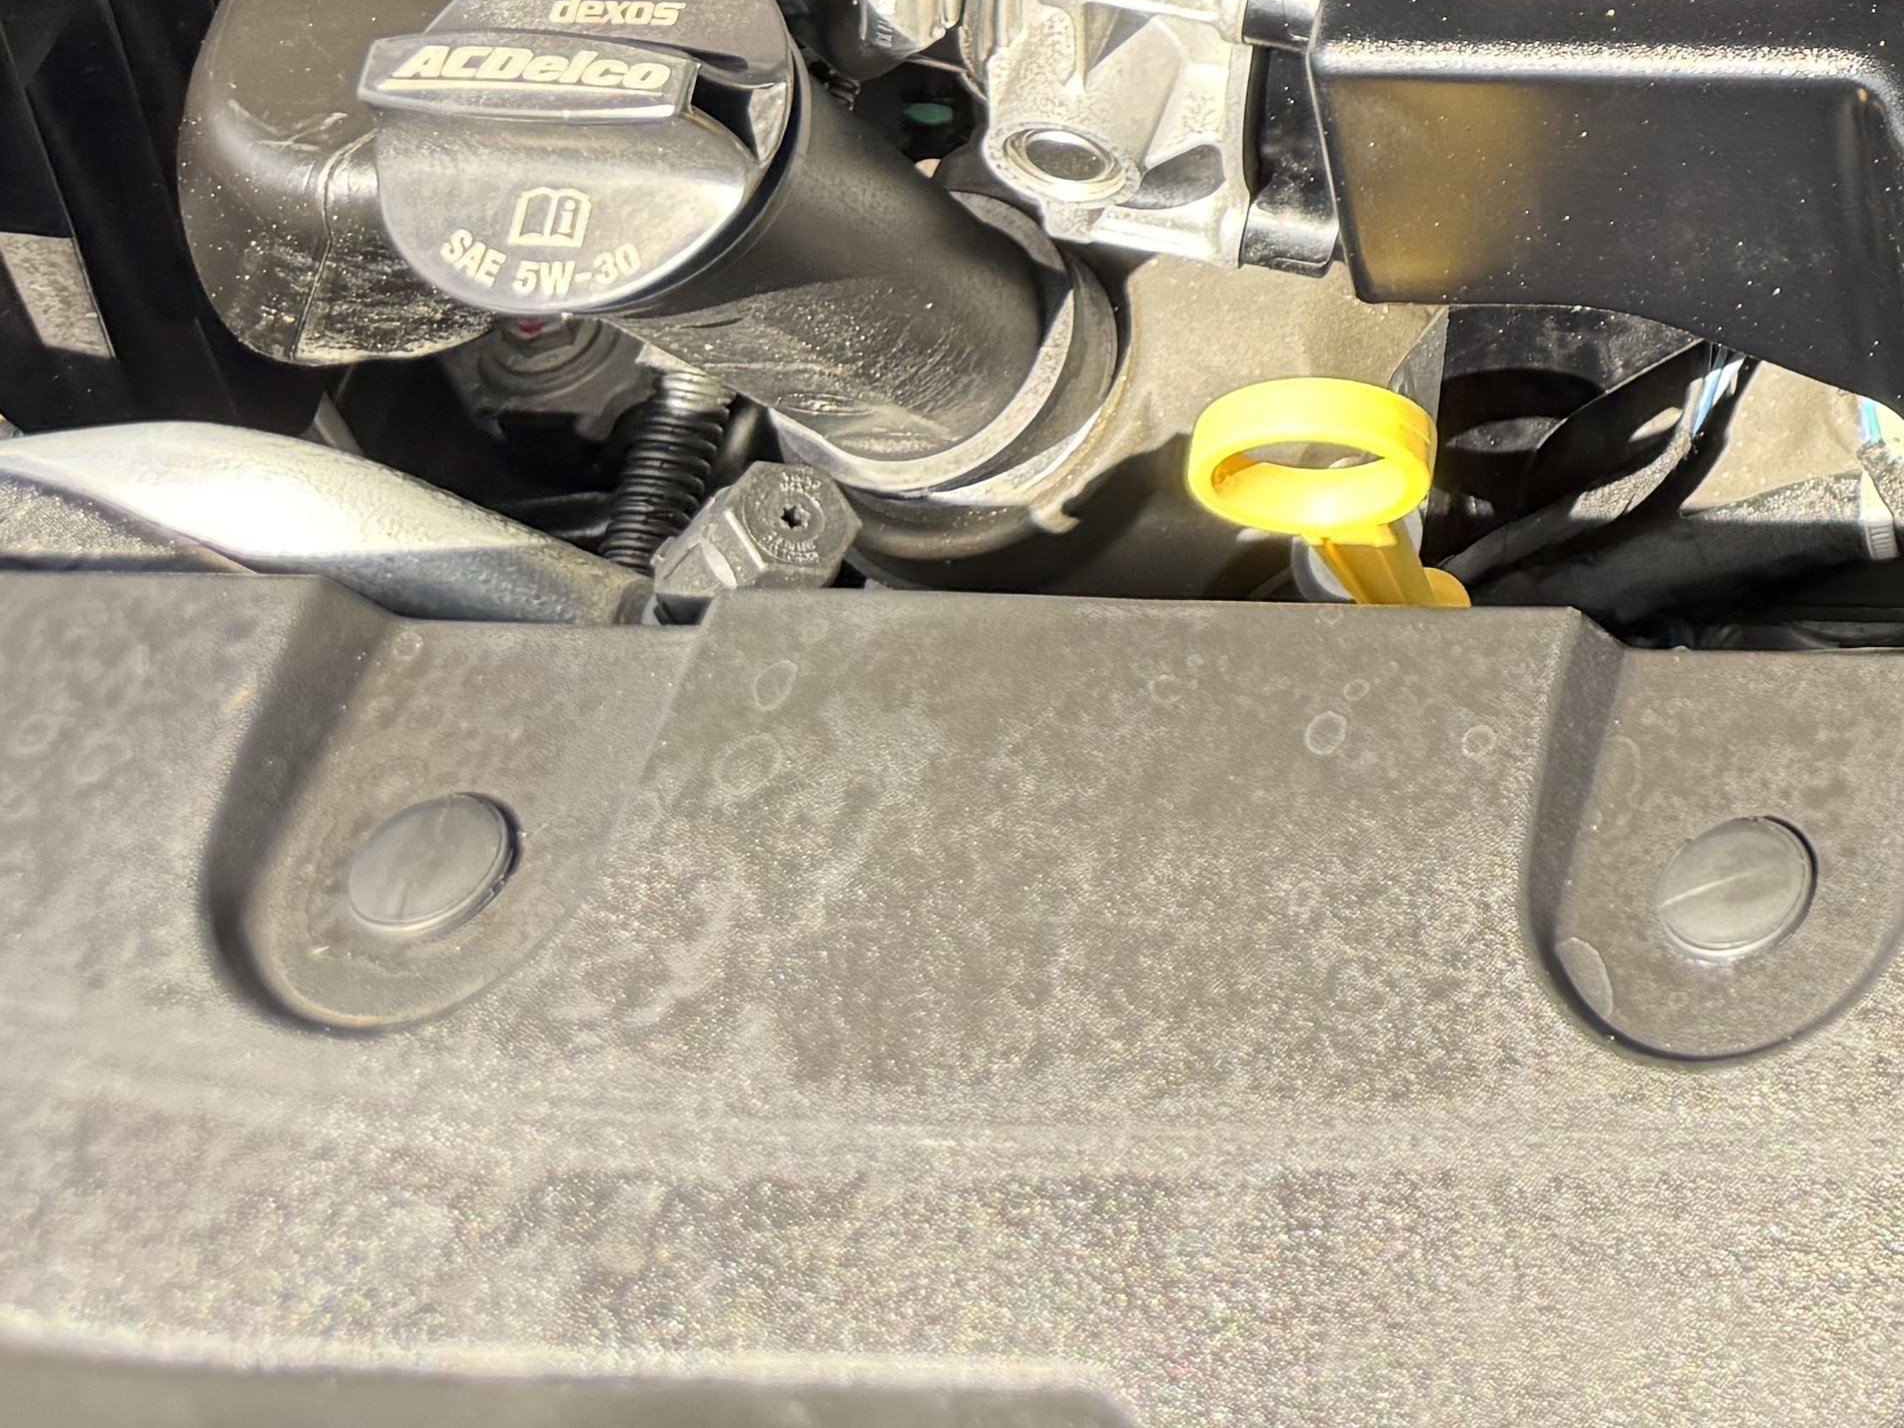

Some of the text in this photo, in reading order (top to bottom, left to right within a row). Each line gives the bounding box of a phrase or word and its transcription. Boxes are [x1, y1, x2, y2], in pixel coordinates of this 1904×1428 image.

[392, 44, 672, 90] ACDelco
[439, 228, 643, 296] SAE 5W-30
